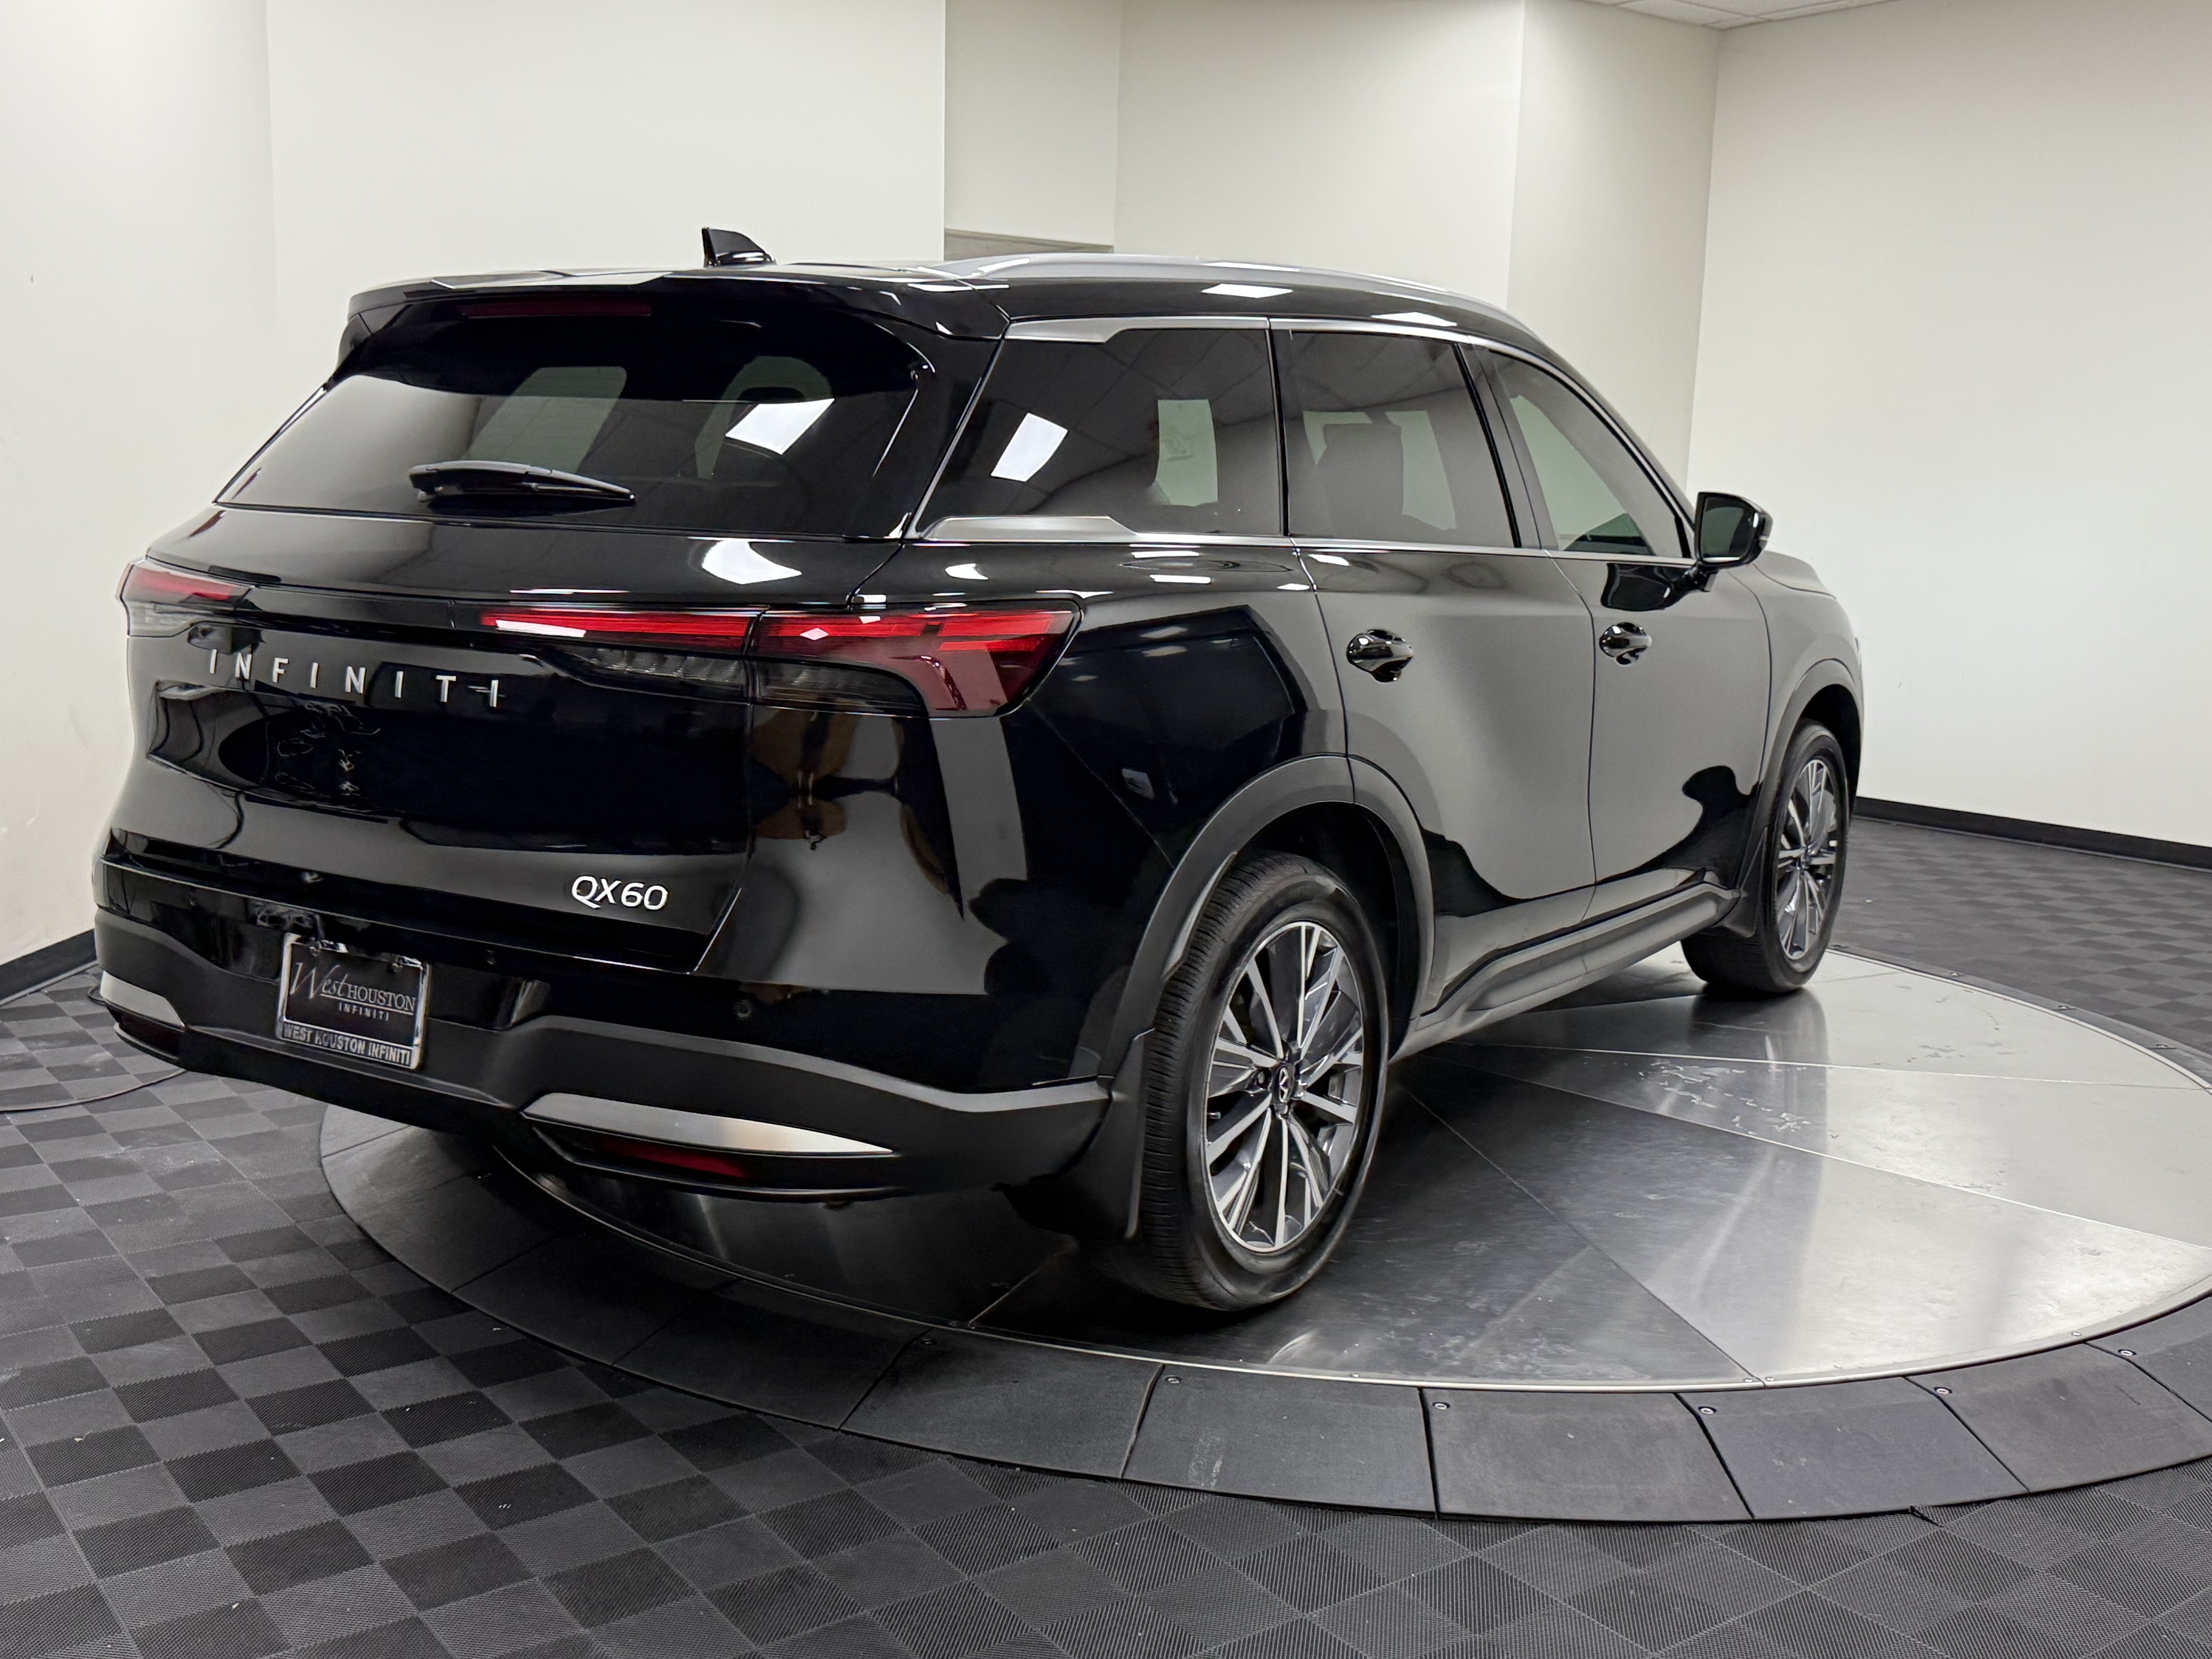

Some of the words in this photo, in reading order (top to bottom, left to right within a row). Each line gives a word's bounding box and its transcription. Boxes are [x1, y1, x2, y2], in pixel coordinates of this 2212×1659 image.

[210, 649, 499, 708] INFINITI
[572, 876, 668, 910] QX60
[290, 962, 348, 1000] West
[347, 984, 416, 1011] HOUSTON
[339, 1002, 390, 1021] INFINITI
[284, 1024, 313, 1041] WEST
[315, 1030, 366, 1055] HOUSTON
[368, 1042, 410, 1065] INFINITI
